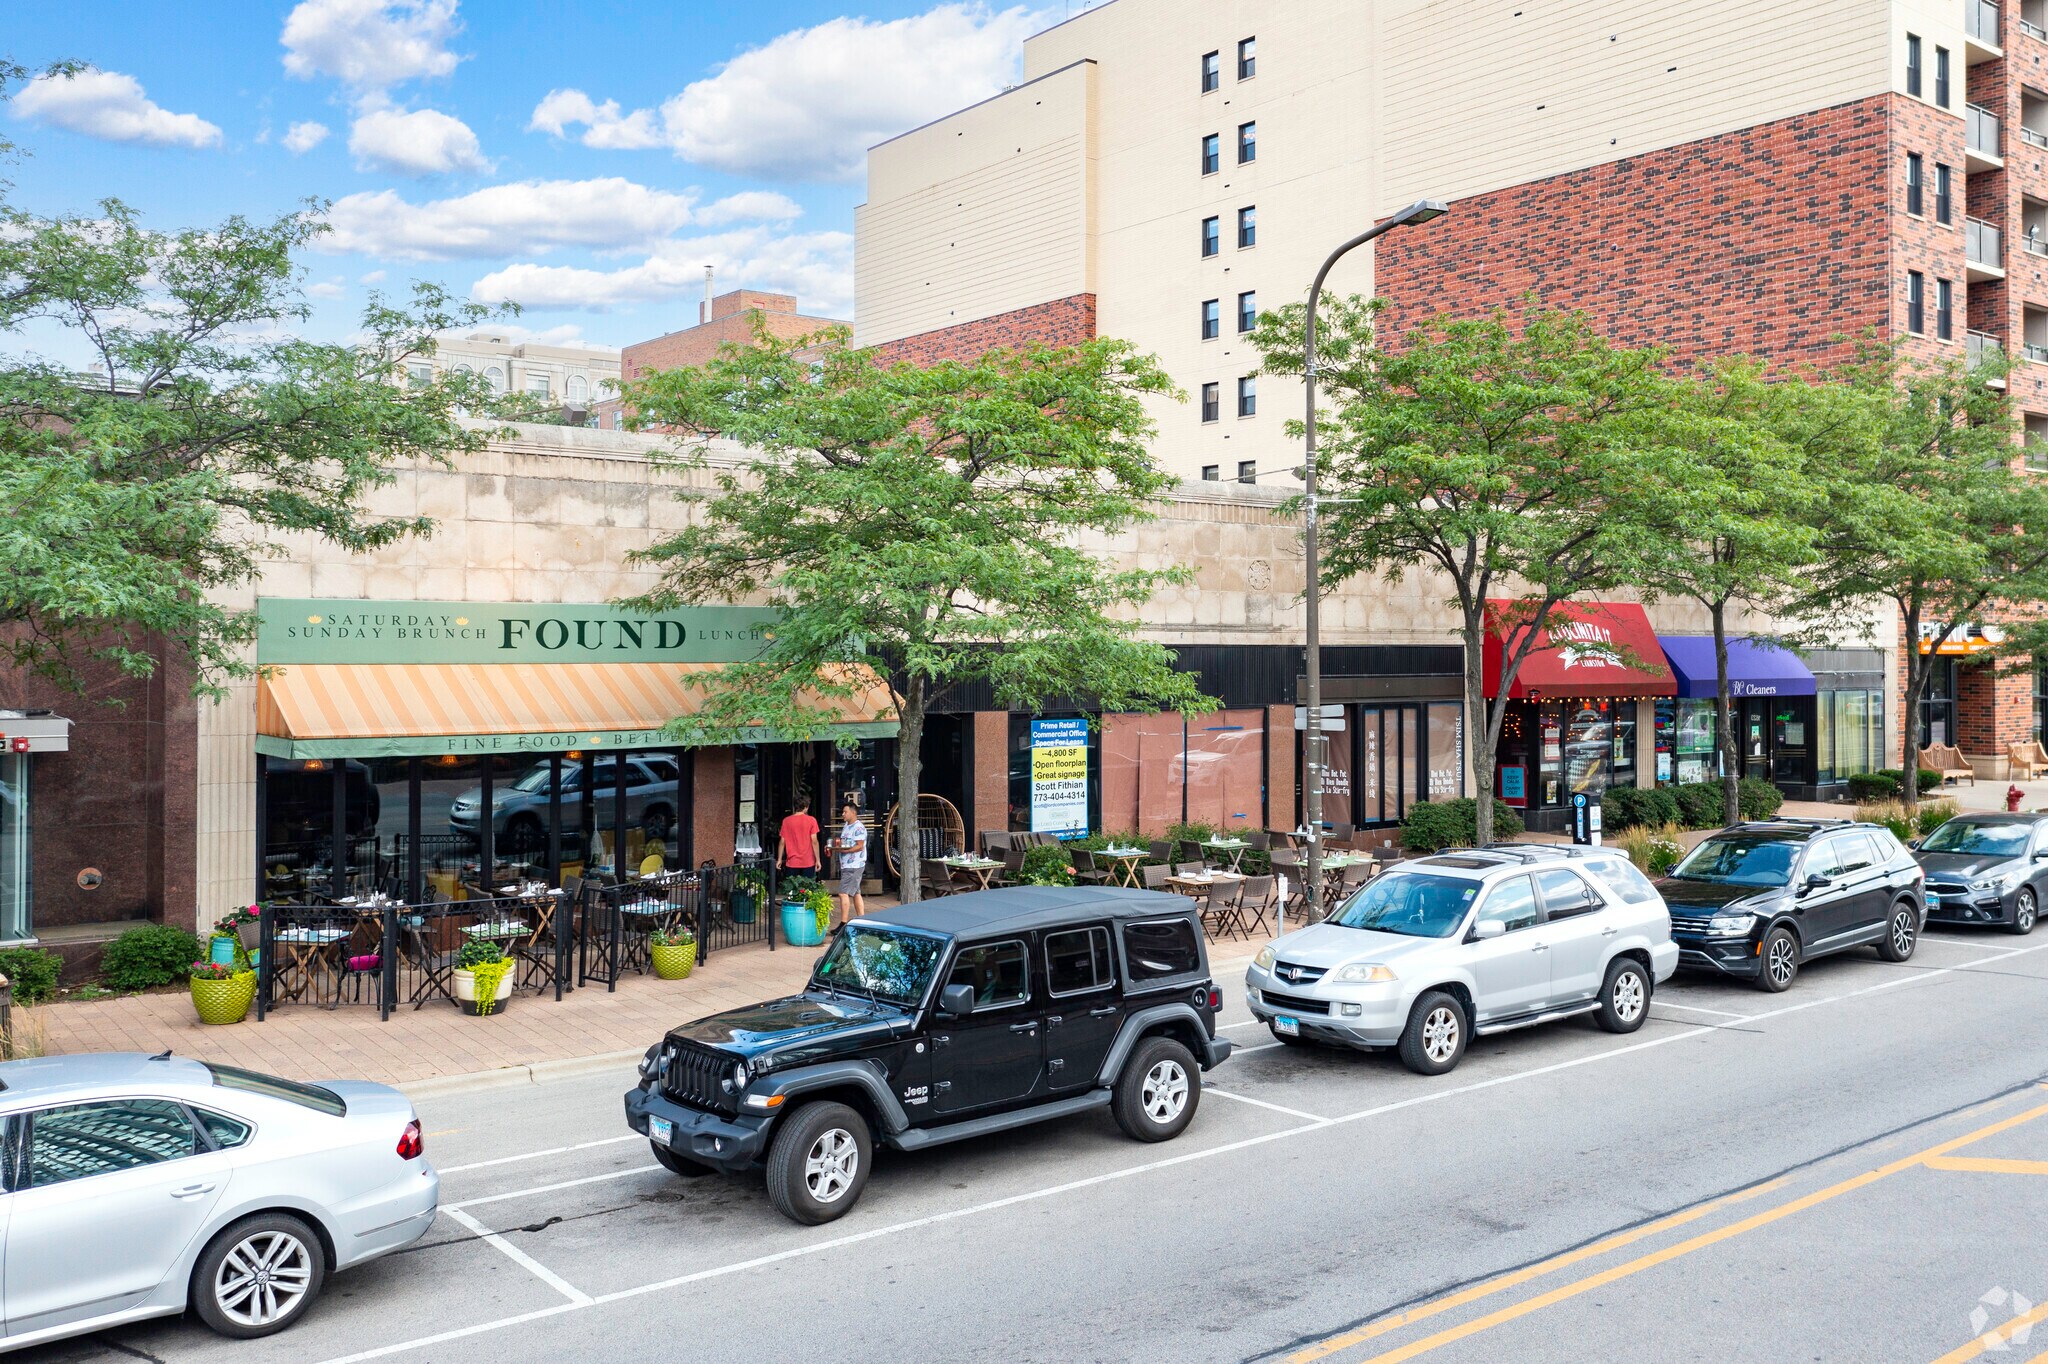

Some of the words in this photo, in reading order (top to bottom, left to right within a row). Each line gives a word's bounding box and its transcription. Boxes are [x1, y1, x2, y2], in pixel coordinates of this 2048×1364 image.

[328, 614, 451, 626] SATURDAY
[287, 626, 383, 638] SUNDAY
[397, 627, 487, 639] BRUNCH
[497, 618, 687, 650] FOUND
[699, 629, 760, 641] LUNCH
[1746, 683, 1777, 695] Cleaners
[1040, 722, 1058, 730] Prime
[1058, 721, 1076, 729] Retail
[1032, 731, 1068, 739] Commercial
[1068, 729, 1087, 737] Office
[448, 737, 502, 750] FINE
[518, 735, 578, 747] FOOD
[1035, 740, 1054, 748] Space
[1066, 738, 1084, 746] Lease
[1068, 748, 1078, 756] SF
[1055, 759, 1087, 768] floorplan
[1057, 769, 1085, 780] signage
[1035, 782, 1057, 791] Scott
[1057, 780, 1084, 790] Fithian
[1033, 790, 1086, 802] 773-404-4314
[904, 1085, 929, 1098] Jeep
